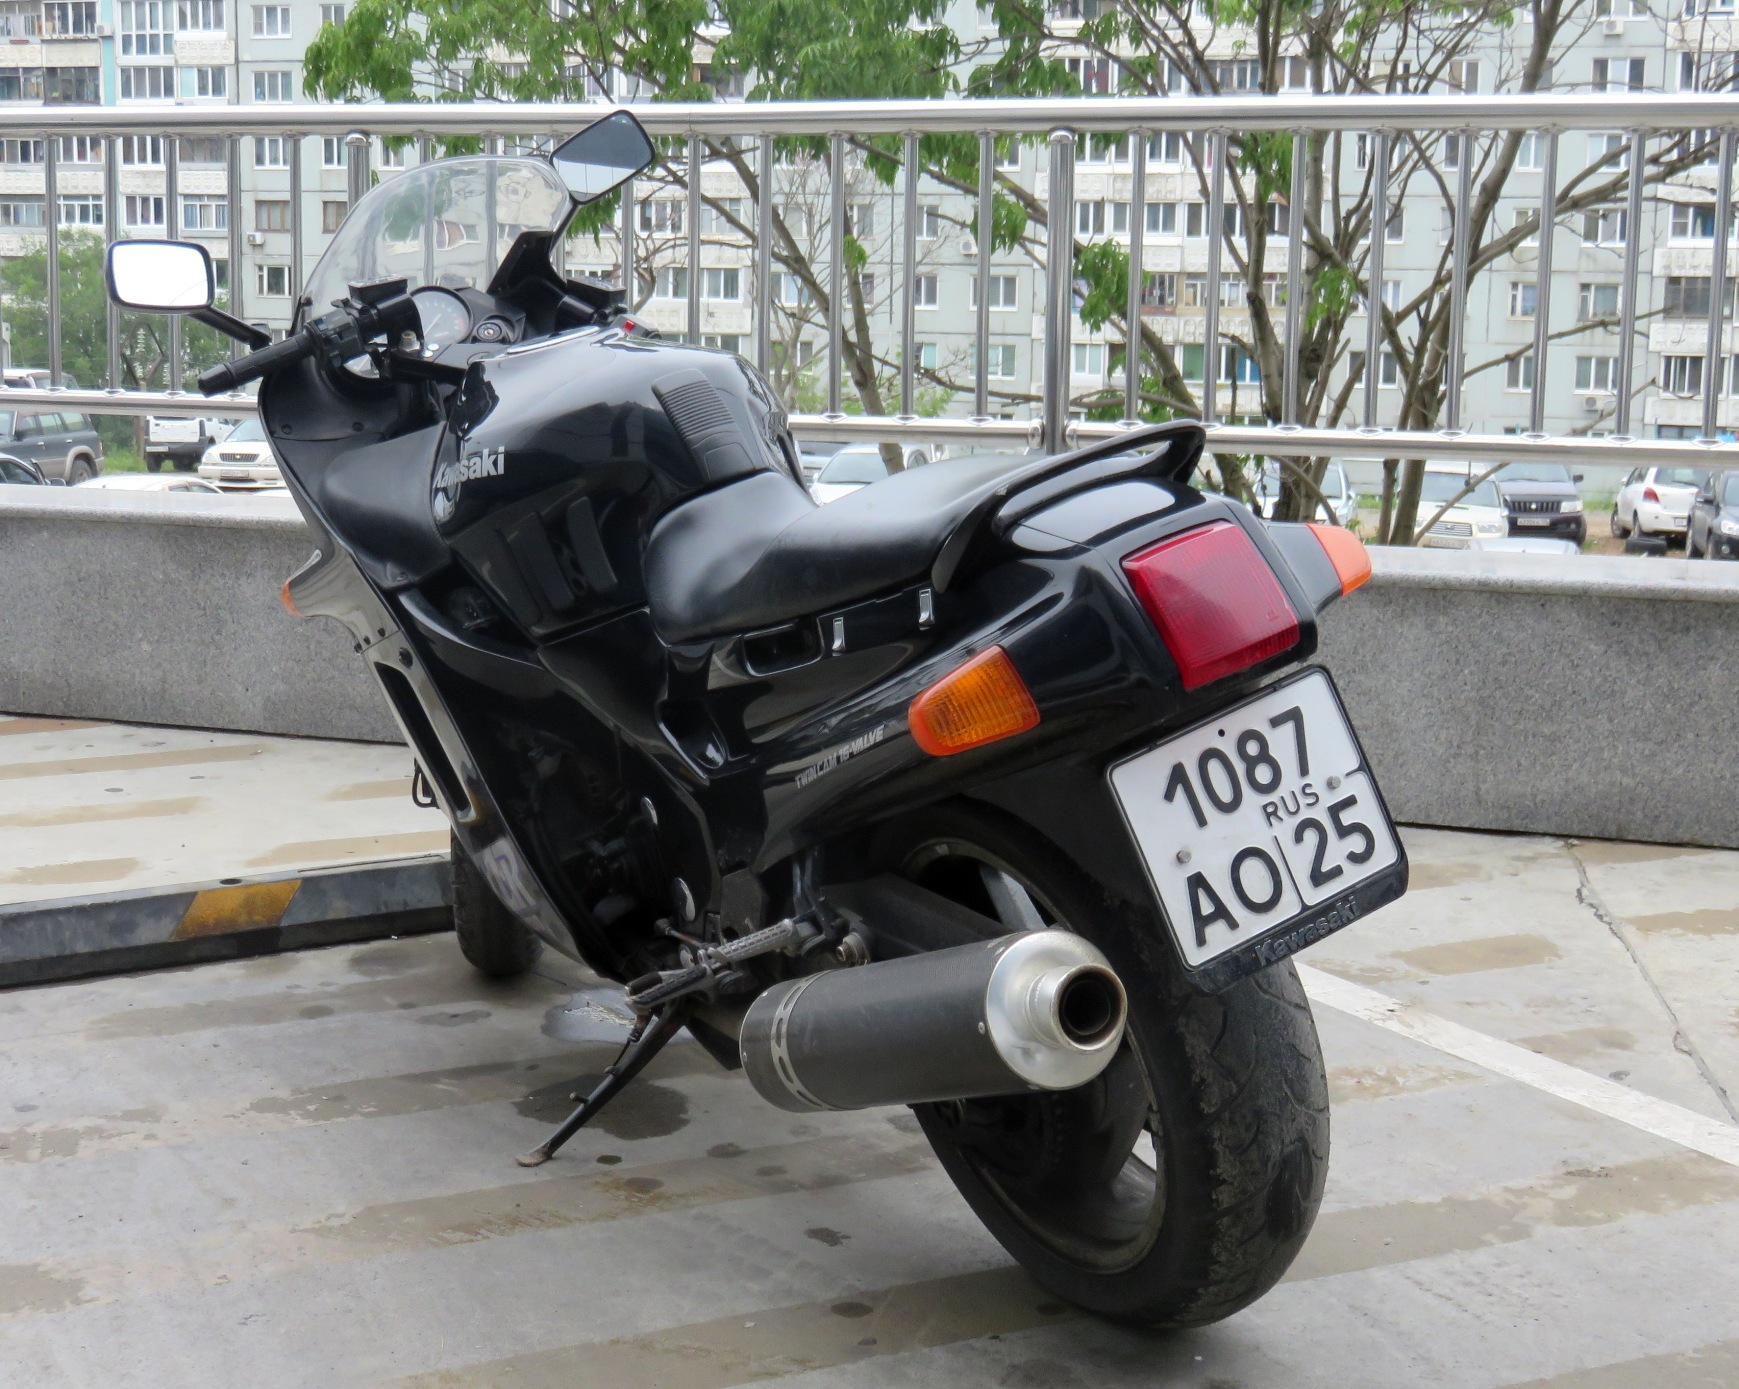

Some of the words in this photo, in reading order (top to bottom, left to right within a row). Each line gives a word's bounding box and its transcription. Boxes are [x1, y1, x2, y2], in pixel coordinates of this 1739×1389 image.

[795, 765, 817, 789] TWIN
[816, 752, 838, 777] CAM
[1163, 705, 1310, 829] 1087
[1261, 783, 1320, 827] RUS
[1186, 846, 1283, 947] AO
[1294, 793, 1376, 889] 25
[1253, 895, 1362, 967] Kawasaki
